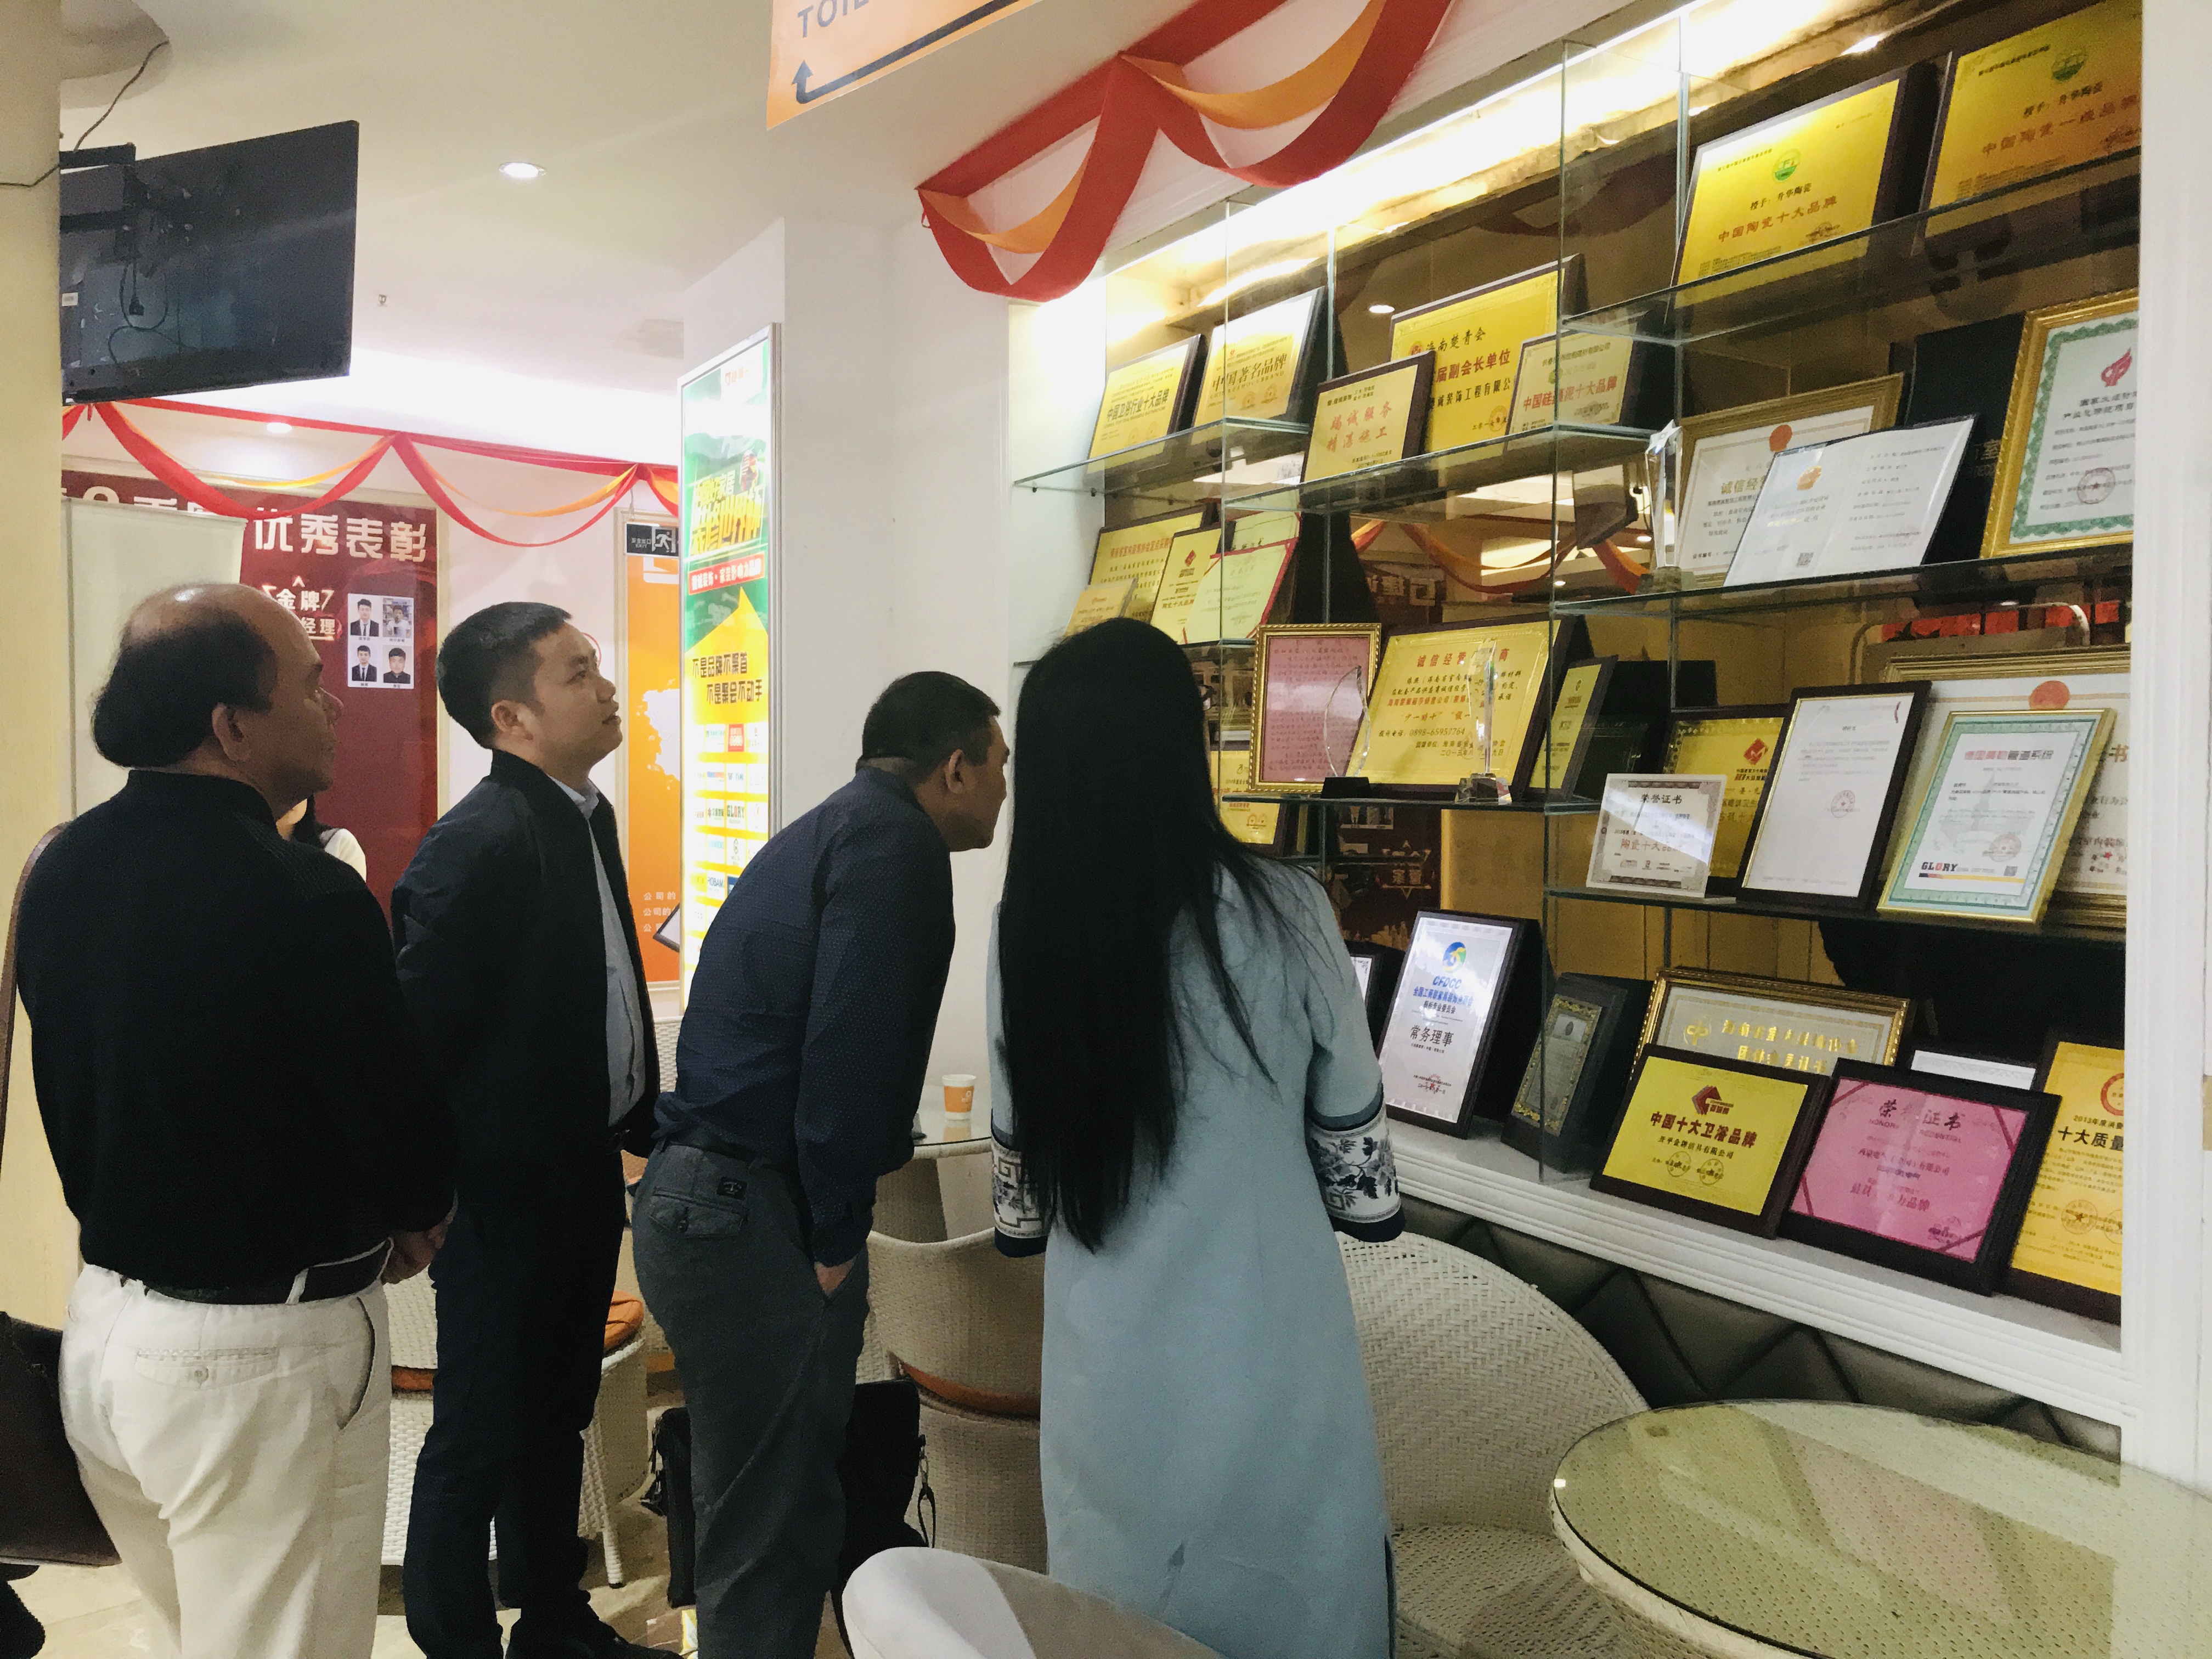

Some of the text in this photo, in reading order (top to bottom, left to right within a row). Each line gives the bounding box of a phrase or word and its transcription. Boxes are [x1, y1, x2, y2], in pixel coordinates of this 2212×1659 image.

[1718, 195, 1837, 242] 中国陶瓷十大品牌
[1212, 353, 1288, 392] 中国著名品牌
[253, 507, 427, 563] 优秀表彰
[276, 588, 320, 612] 金牌
[300, 617, 336, 635] 经理
[692, 651, 748, 679] 不是品牌不聚首
[706, 679, 763, 705] 不是聚会不动手
[1640, 793, 1683, 805] 荣誉证书
[727, 805, 745, 819] GLORY
[1921, 861, 1959, 872] GLORY
[643, 891, 676, 901] 公司的
[1432, 975, 1462, 990] CFDCC
[1409, 1024, 1454, 1047] 常务理事
[1879, 1098, 1966, 1131] 荣证书
[1650, 1110, 1757, 1148] 中国十大卫浴品牌
[2057, 1126, 2124, 1152] 十大质量
